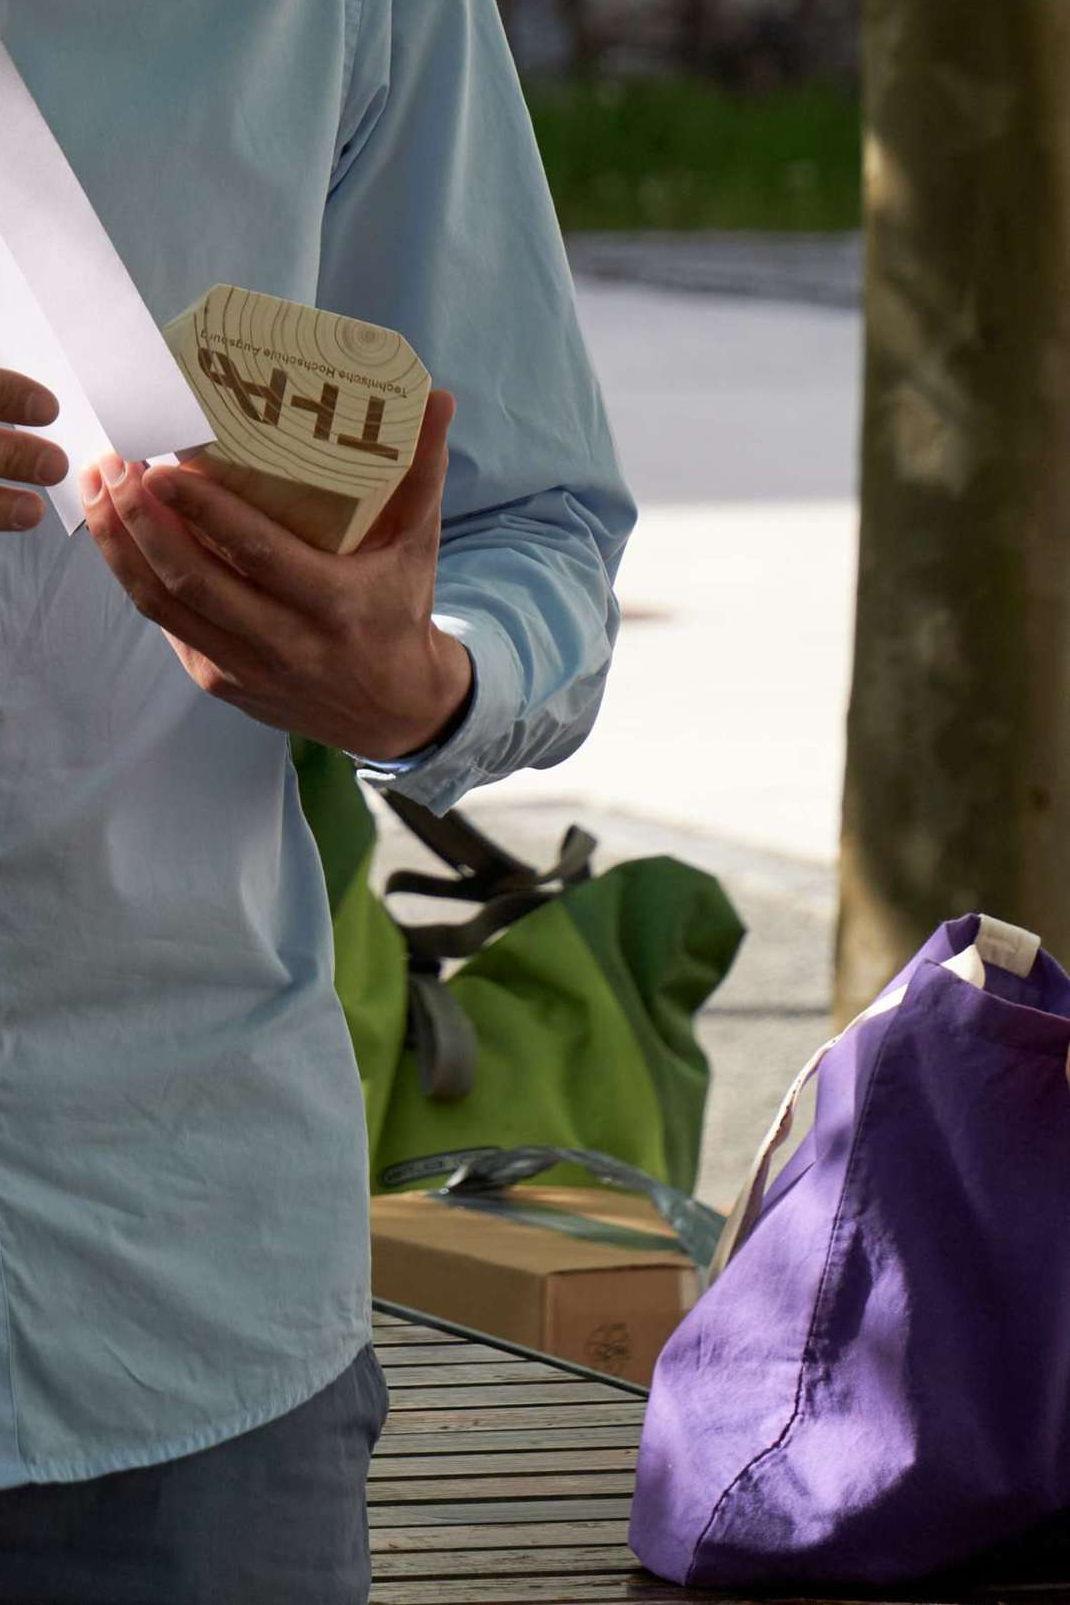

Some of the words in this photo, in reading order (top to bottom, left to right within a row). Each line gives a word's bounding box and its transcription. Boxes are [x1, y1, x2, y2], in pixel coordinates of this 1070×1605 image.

[200, 330, 262, 357] Augsburg
[263, 348, 336, 377] Hochschule
[338, 370, 408, 398] Technische
[197, 346, 399, 461] THA
